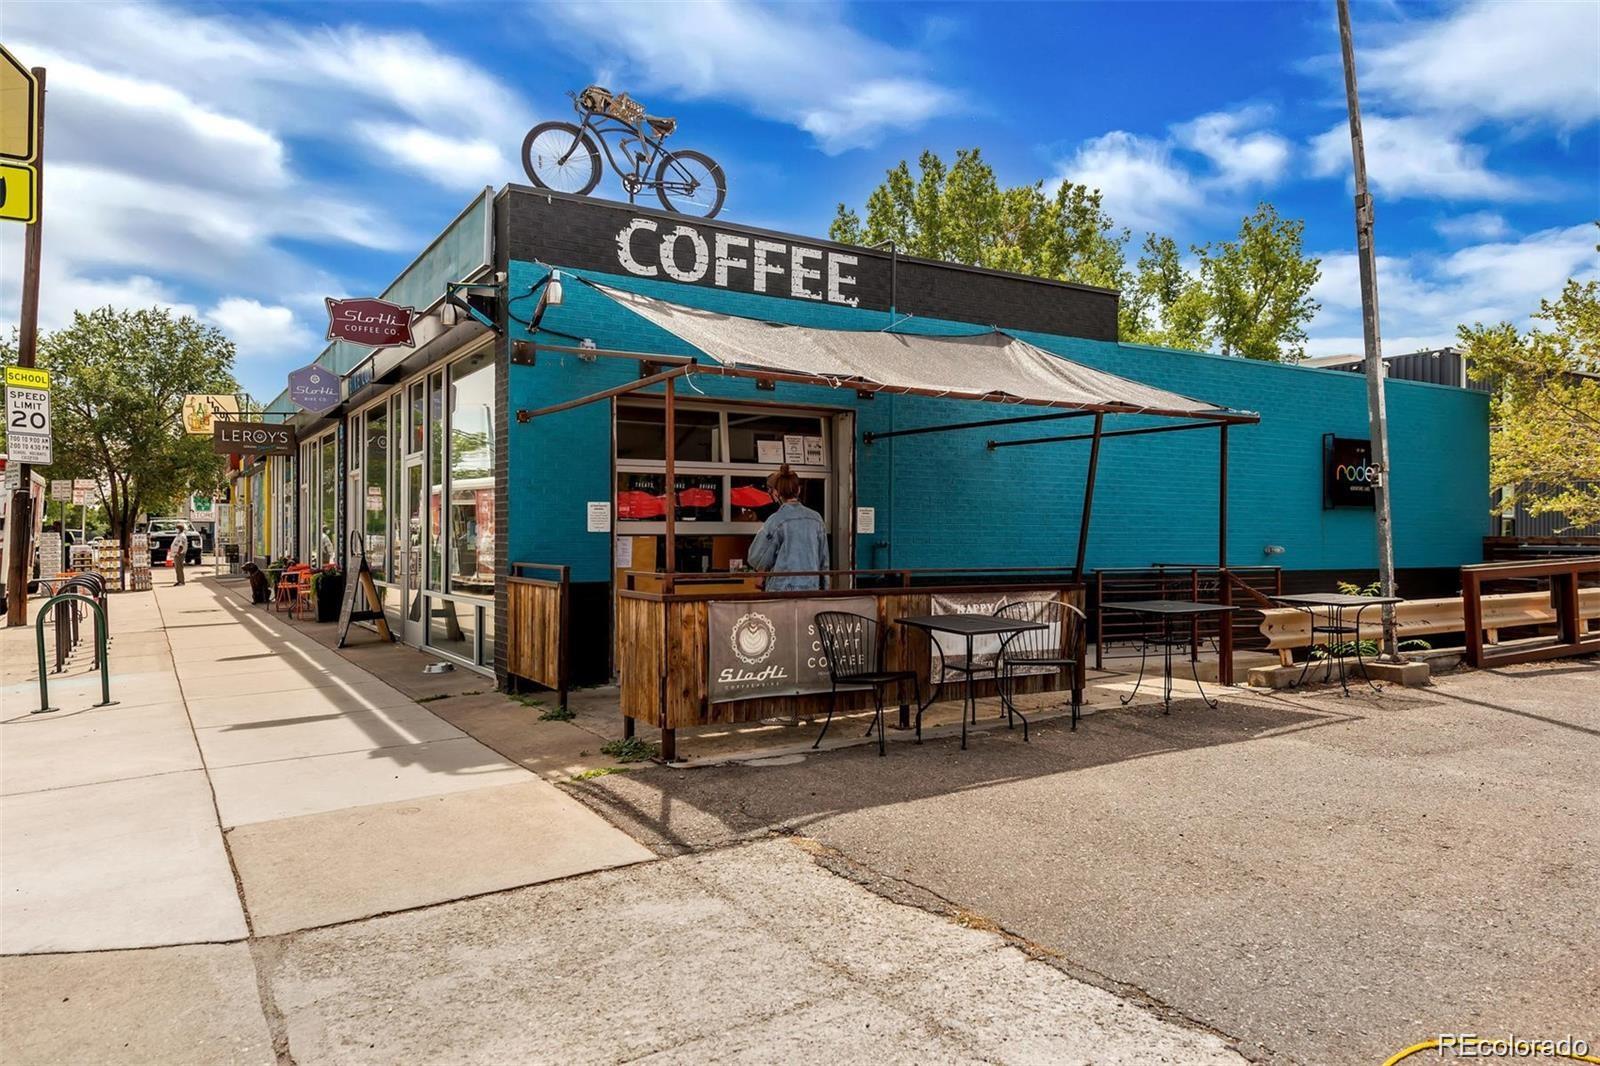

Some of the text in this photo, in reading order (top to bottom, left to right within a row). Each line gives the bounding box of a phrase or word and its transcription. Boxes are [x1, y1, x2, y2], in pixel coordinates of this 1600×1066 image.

[615, 218, 860, 308] COFFEE
[336, 310, 405, 325] SloHi
[344, 324, 400, 336] COFFEE CO.
[8, 372, 47, 384] SCHOOL
[10, 390, 46, 402] SPEED
[293, 385, 338, 396] SloHi
[14, 401, 42, 411] LIMIT
[11, 410, 46, 430] 20
[221, 429, 288, 444] LEROY'S
[1336, 457, 1375, 482] rode
[956, 603, 994, 614] HAPPY
[807, 654, 865, 669] COFEE
[718, 665, 788, 682] SloHi
